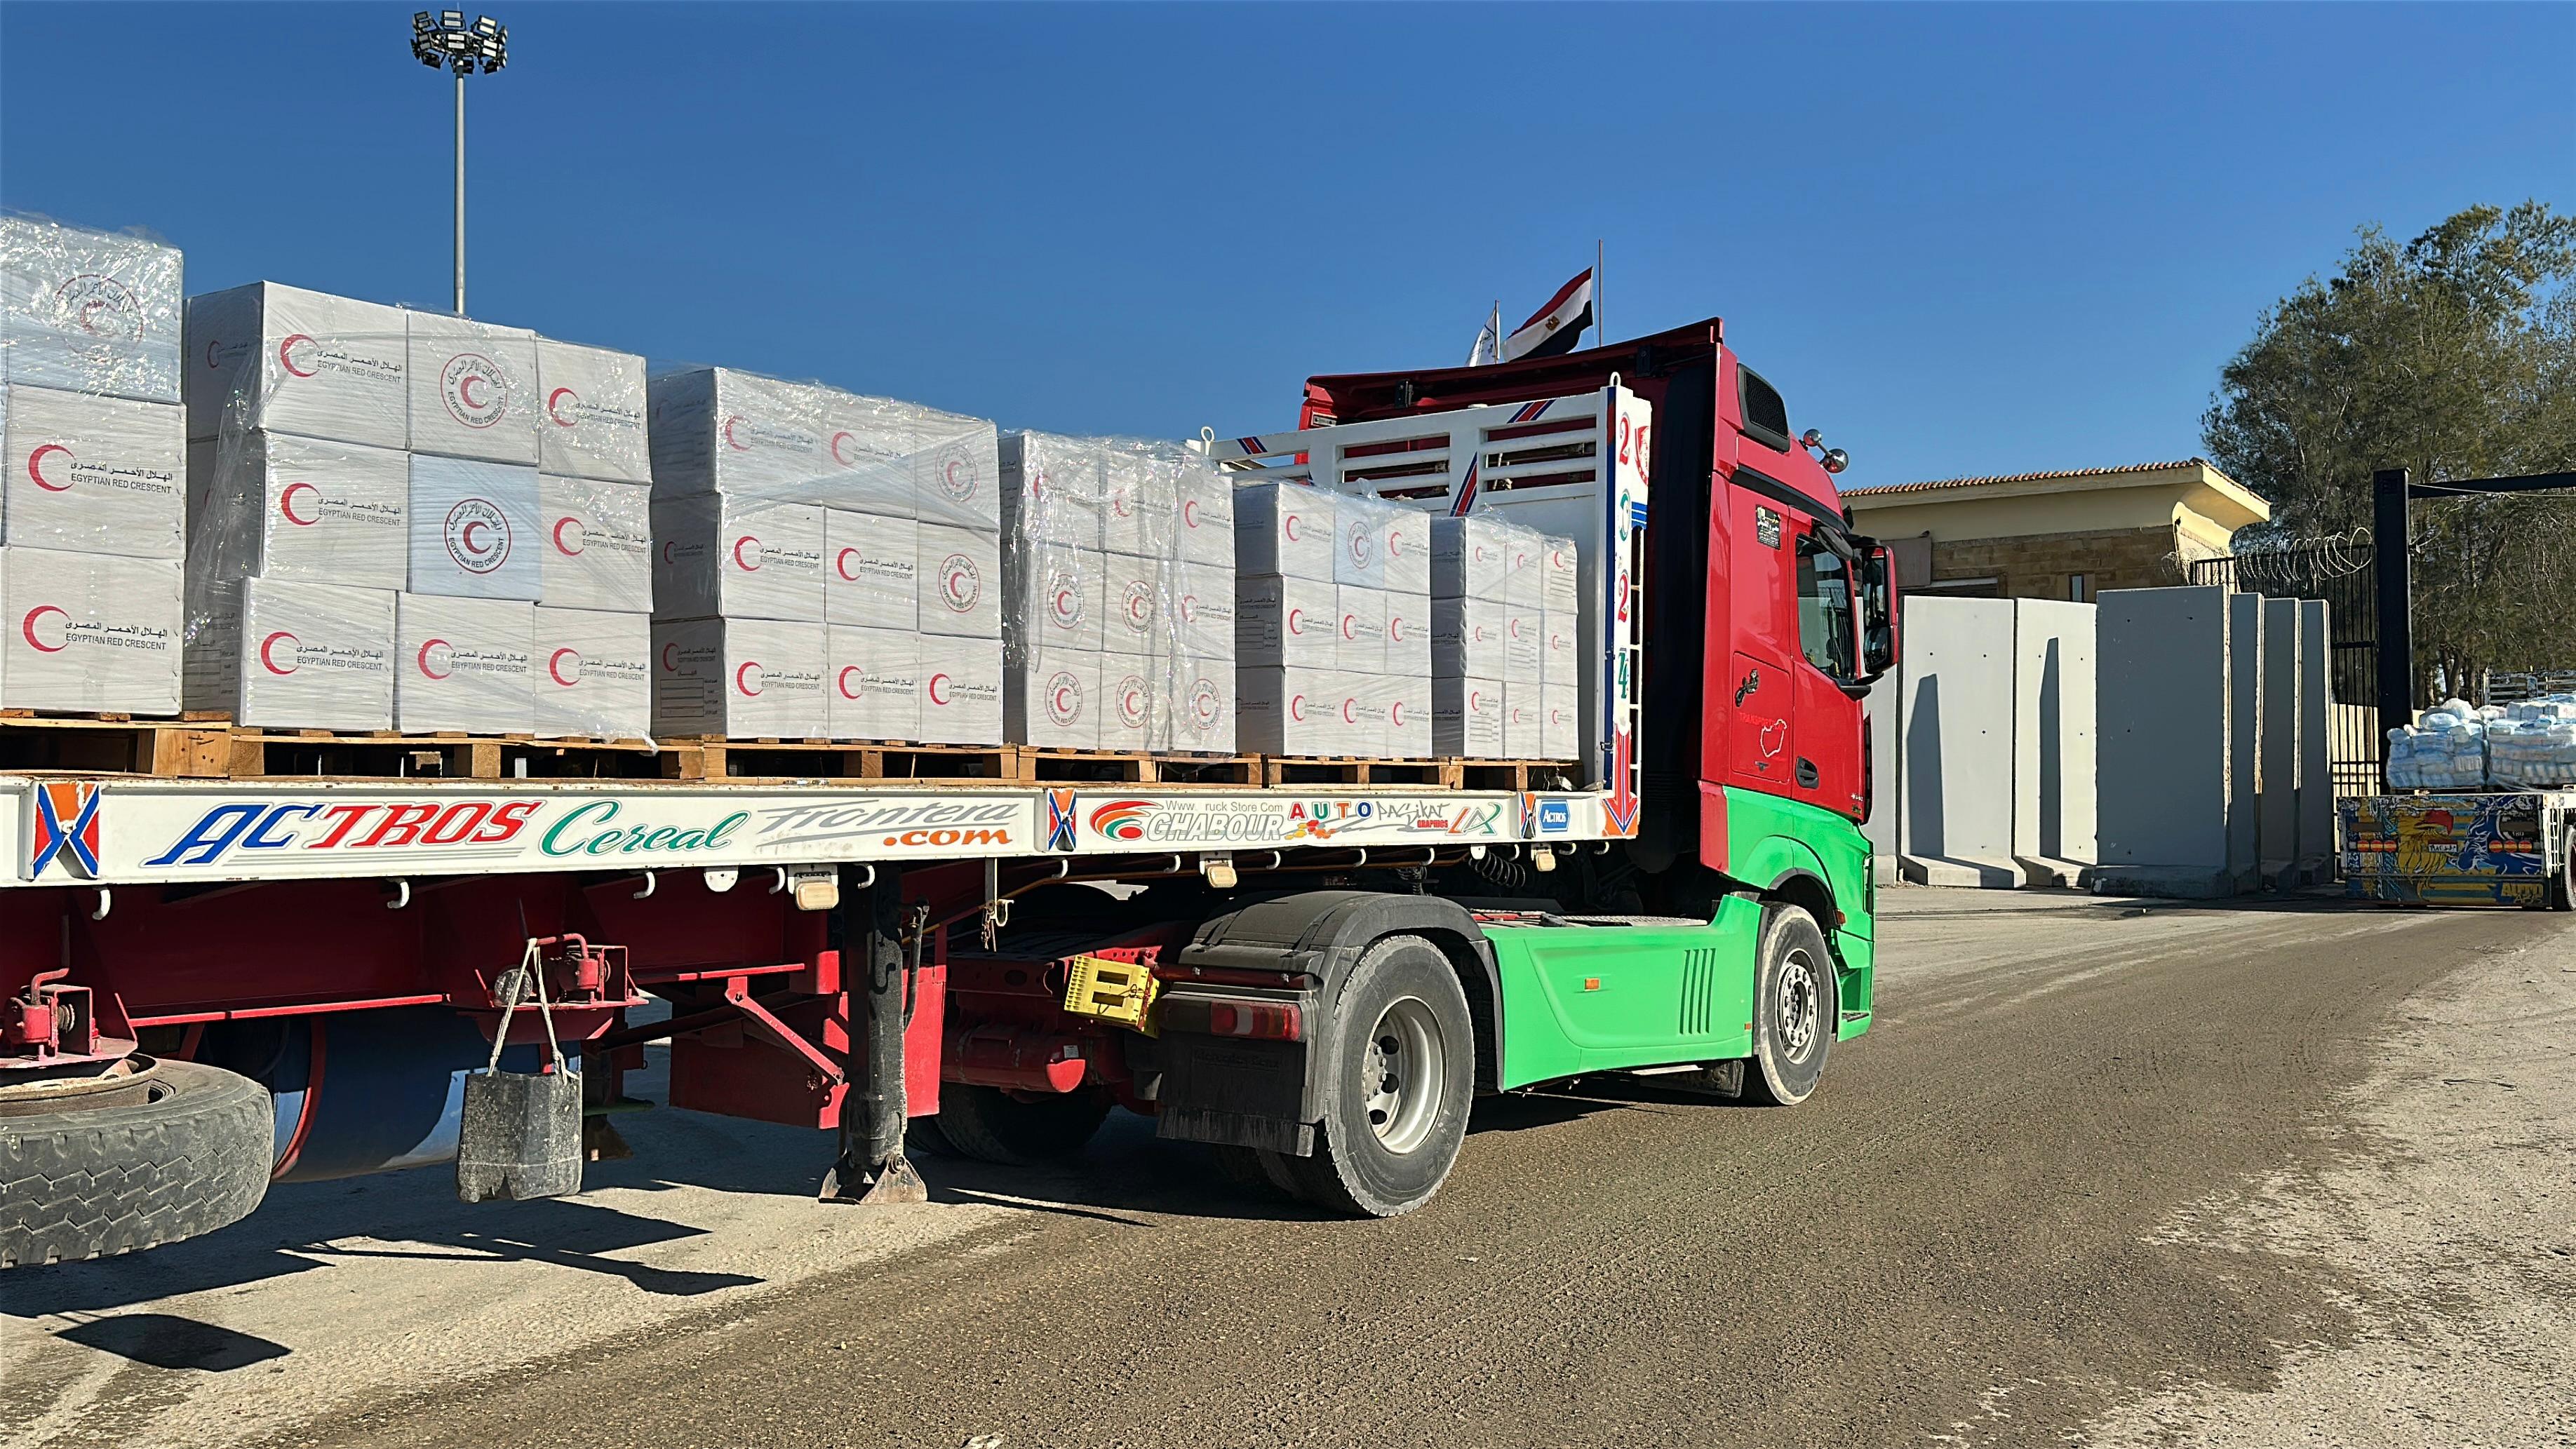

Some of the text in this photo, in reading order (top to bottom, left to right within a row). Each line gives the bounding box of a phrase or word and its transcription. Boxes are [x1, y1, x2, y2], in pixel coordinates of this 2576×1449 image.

[318, 360, 350, 373] EGYPTIAN
[367, 371, 401, 384] CRESCENT
[448, 391, 469, 421] EGYPTIAN
[72, 473, 110, 485] EGYPTIAN
[131, 483, 171, 494] CRESCENT
[319, 508, 350, 519] EGYPTIAN
[368, 515, 400, 526] CRESCENT
[449, 537, 470, 565] EGYPTIAN
[485, 537, 504, 565] CRESCENT
[583, 539, 608, 548] EGYPTIAN
[622, 544, 646, 553] CRESCENT
[760, 555, 783, 564] EGYPTIAN
[67, 633, 166, 650] EGYPTIAN RED CRESCENT
[297, 656, 330, 666] EGYPTIAN
[347, 661, 382, 670] CRESCENT
[452, 661, 481, 670] EGYPTIAN
[496, 664, 526, 673] CRESCENT
[579, 669, 605, 678] EGYPTIAN
[1230, 802, 1257, 812] Store
[1261, 802, 1283, 812] Com
[1289, 801, 1373, 820] AUTO
[758, 800, 1019, 835] Frontera
[1417, 819, 1449, 828] GRAPHICS
[142, 802, 542, 868] ACTROS
[539, 800, 752, 856] Cereal
[883, 828, 1013, 847] .com
